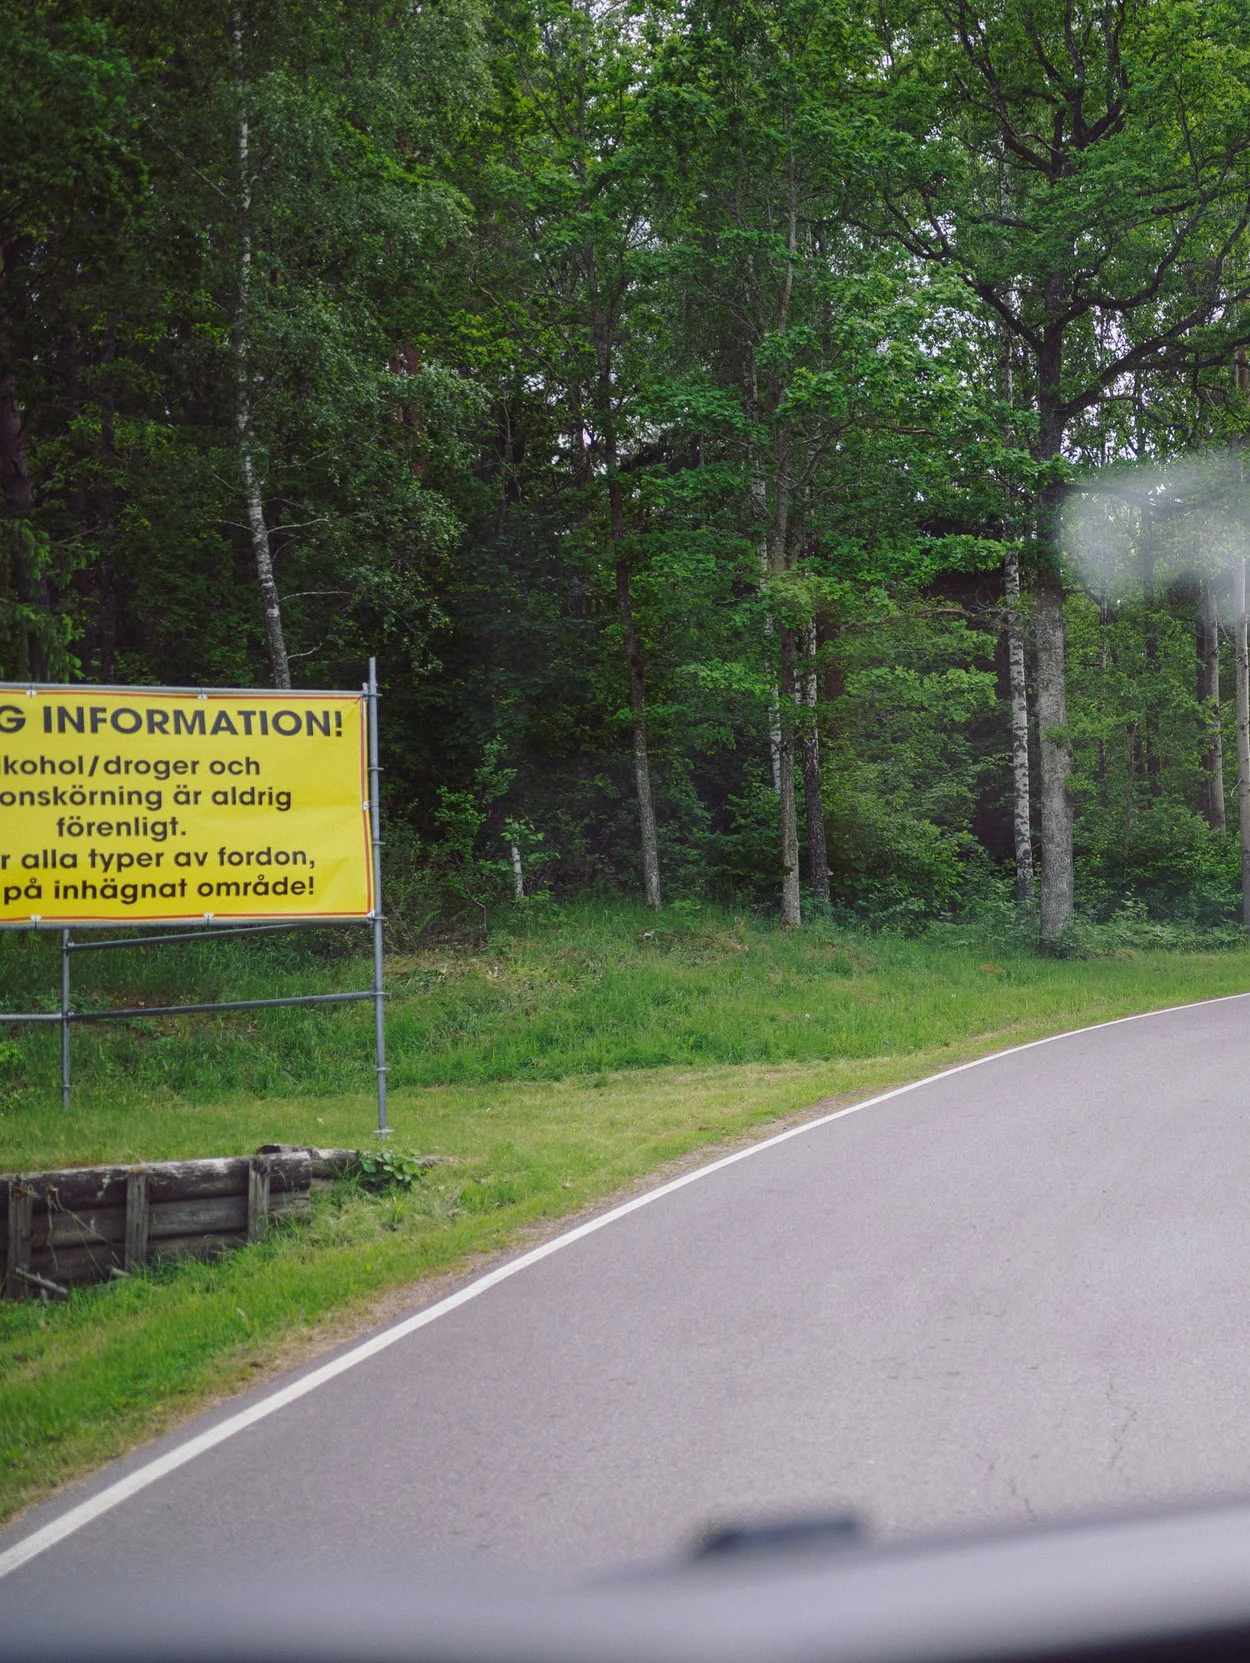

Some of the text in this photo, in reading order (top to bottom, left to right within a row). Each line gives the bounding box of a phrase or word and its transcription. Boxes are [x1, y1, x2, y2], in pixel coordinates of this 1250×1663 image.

[42, 705, 343, 737] INFORMATION!
[209, 756, 260, 776] och
[173, 784, 202, 806] är
[211, 786, 292, 812] aldrig
[56, 815, 187, 843] förenligt.
[20, 848, 78, 870] alla
[88, 848, 165, 873] typer
[174, 851, 209, 868] av
[217, 846, 315, 869] fordon,
[3, 874, 314, 906] på inhägnat område!
